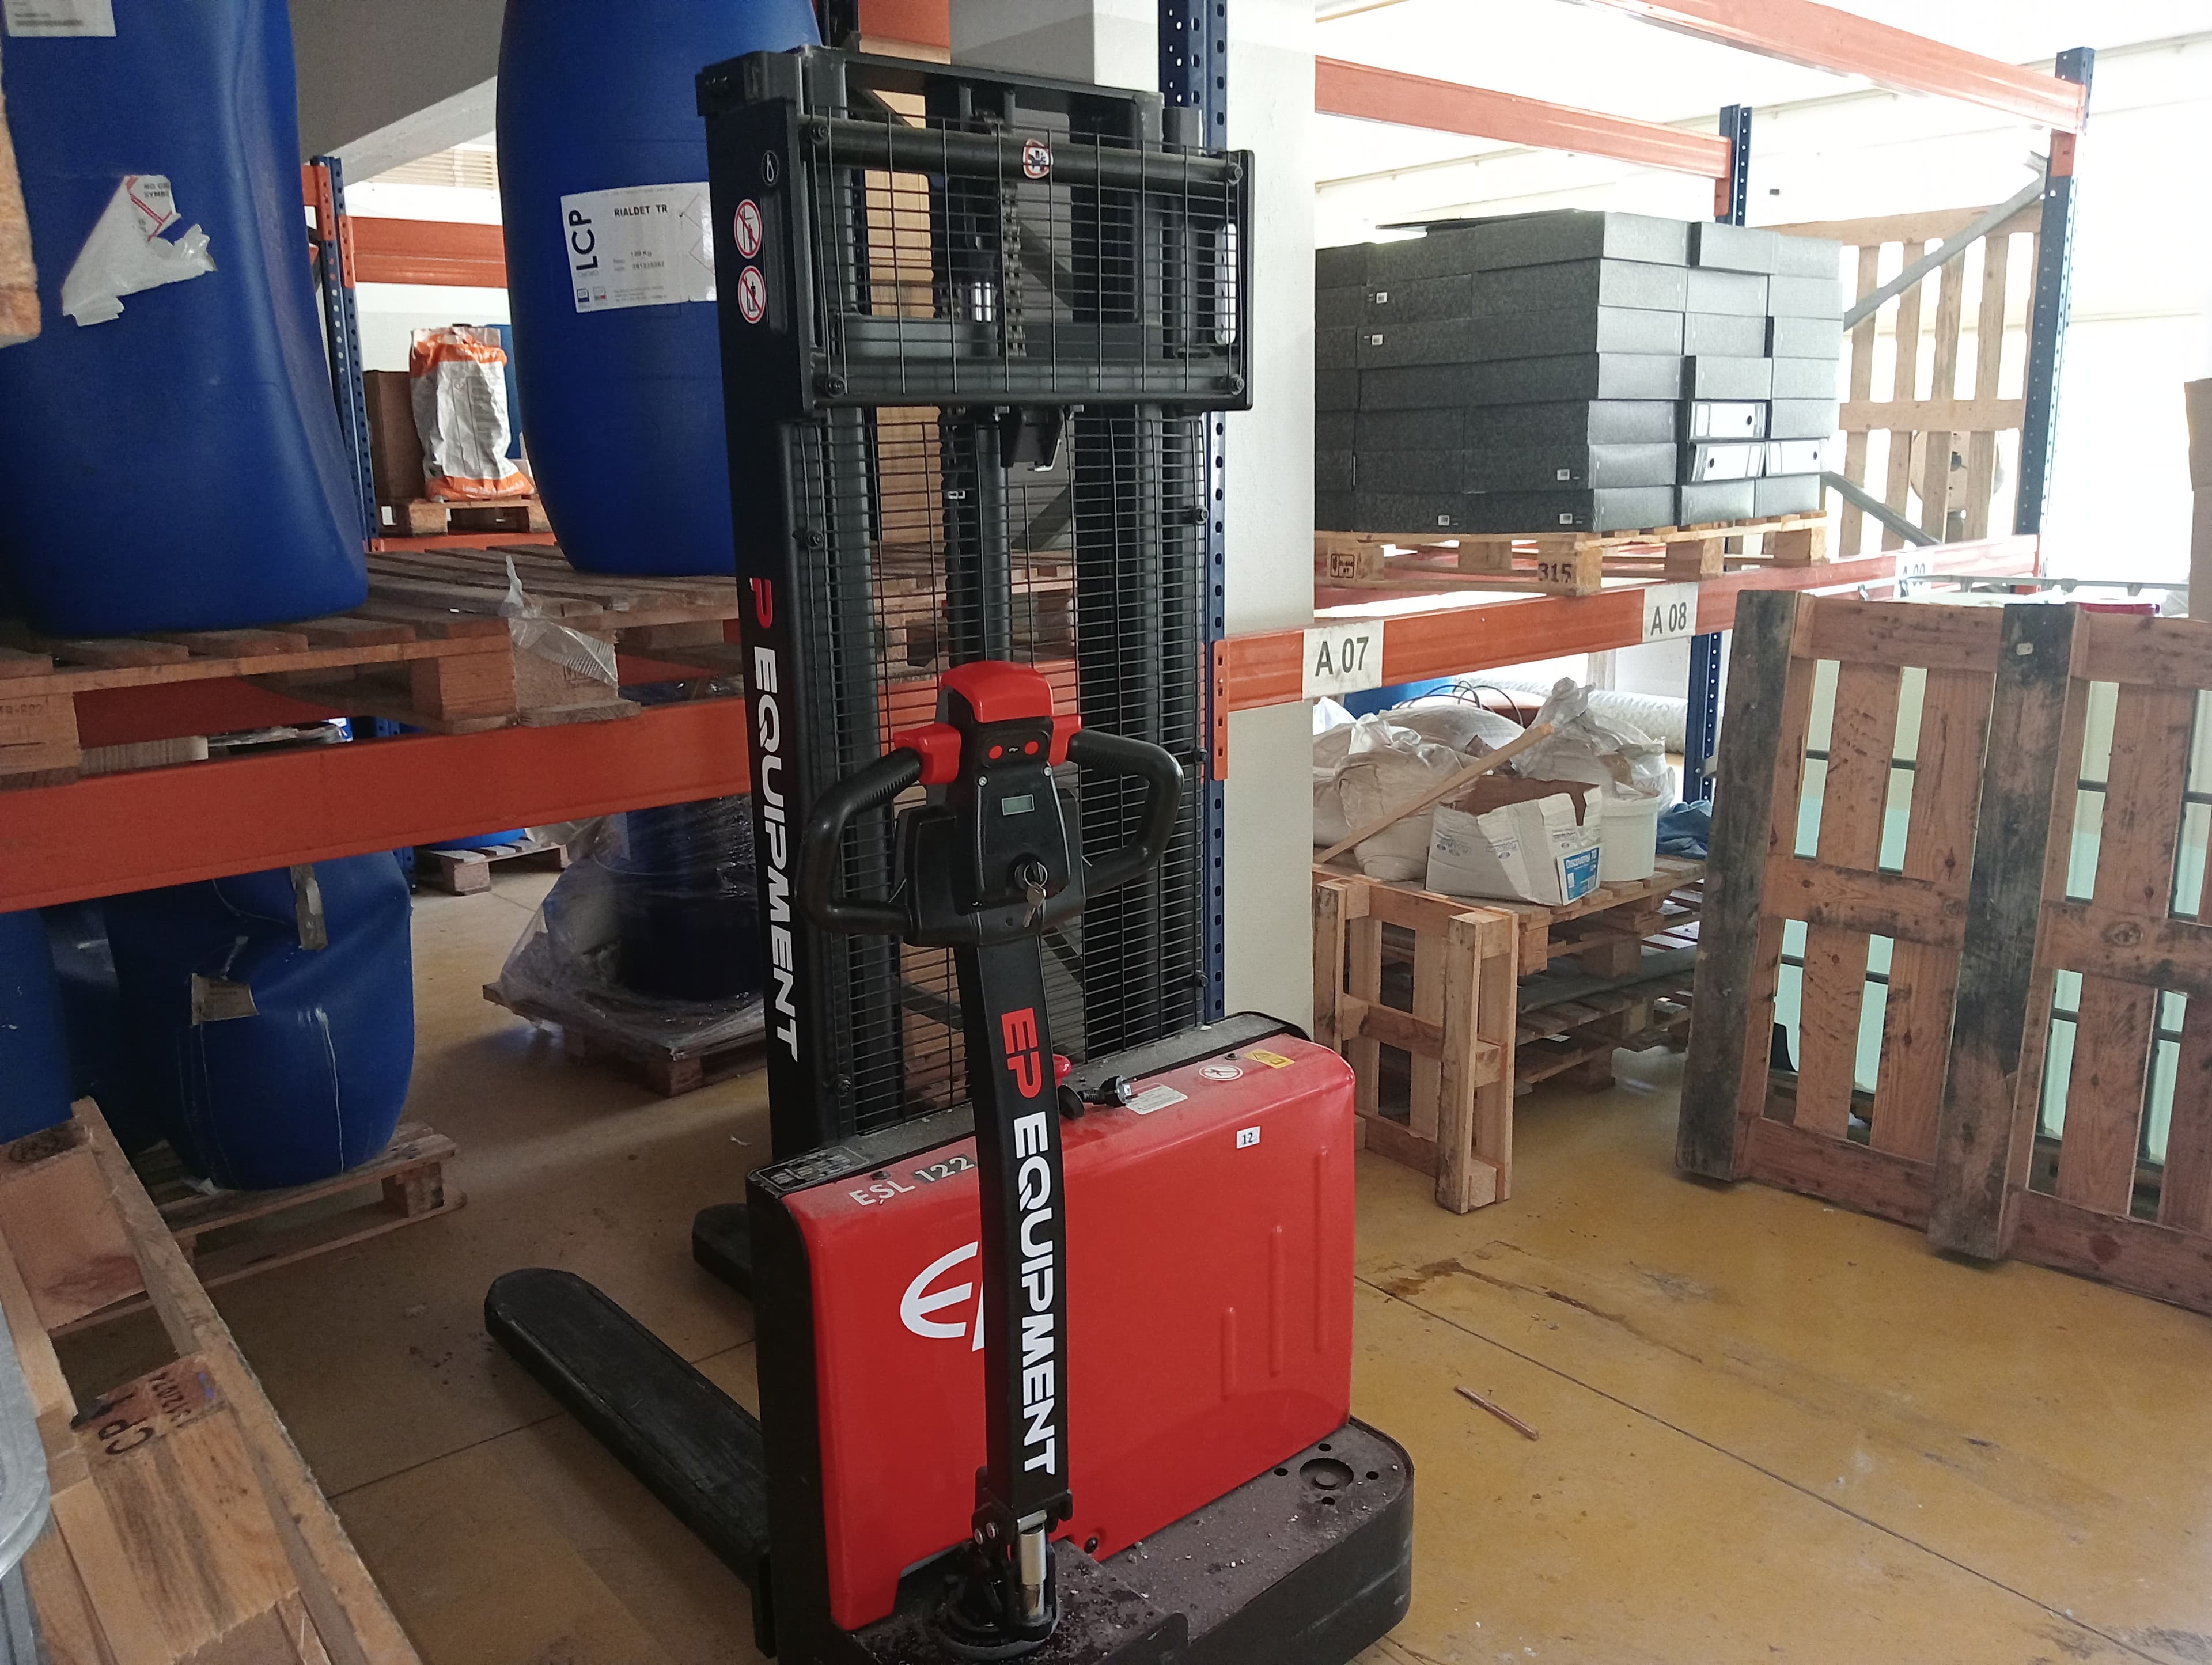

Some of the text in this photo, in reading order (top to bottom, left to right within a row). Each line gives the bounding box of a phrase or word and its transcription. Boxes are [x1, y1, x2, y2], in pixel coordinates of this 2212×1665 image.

[614, 204, 668, 217] RIALDET TR
[568, 210, 599, 271] LCP
[1539, 563, 1571, 583] 315
[1650, 601, 1687, 636] A 08
[1315, 636, 1369, 677] A 07
[753, 646, 798, 1063] EQUIPMENT
[1001, 1007, 1043, 1099] EP
[1242, 1132, 1253, 1145] 12
[849, 1156, 975, 1207] ESL 122
[900, 1240, 985, 1352] E
[1014, 1110, 1055, 1476] EQUIPMENT
